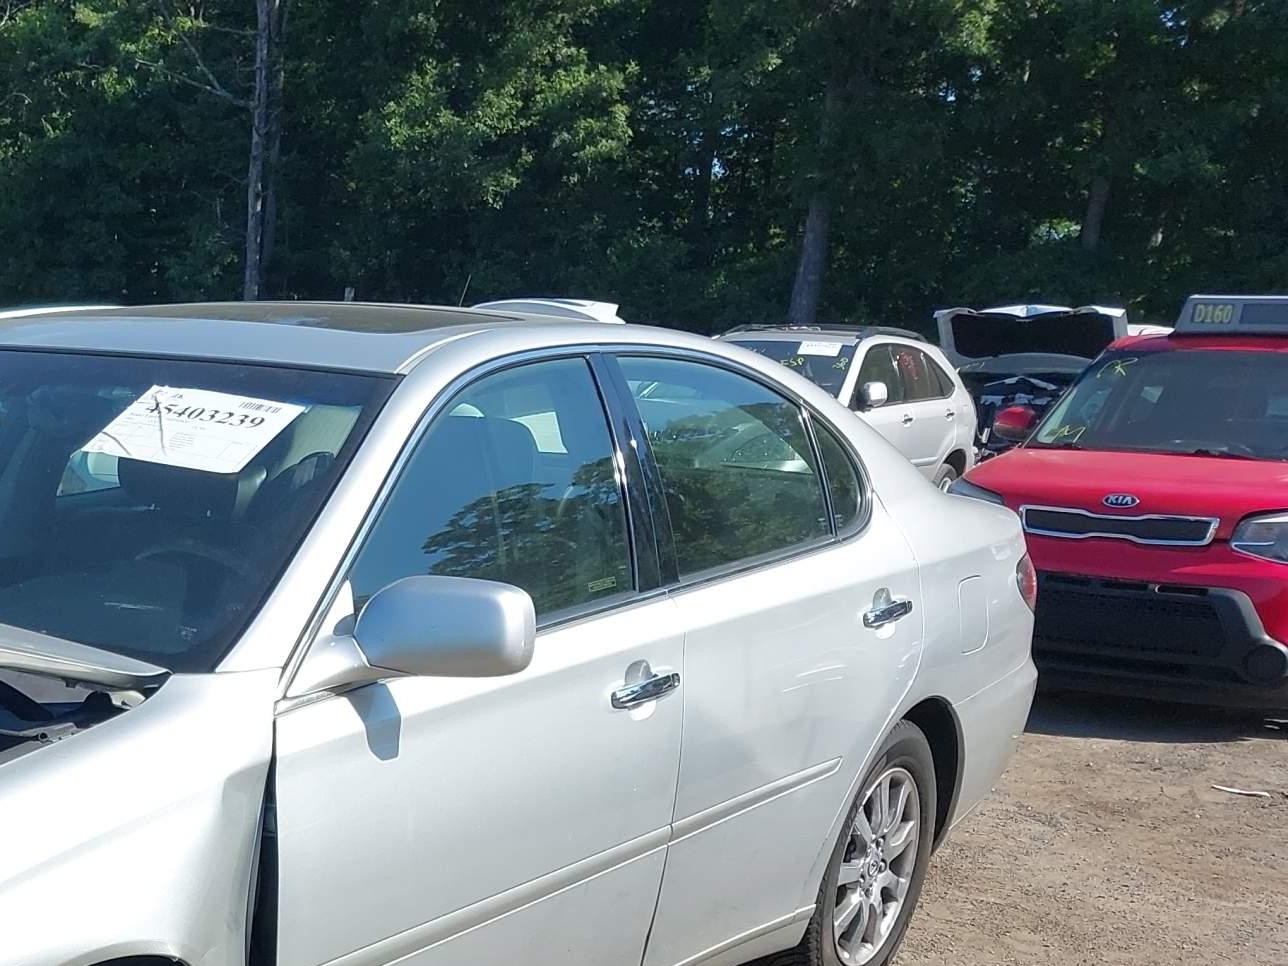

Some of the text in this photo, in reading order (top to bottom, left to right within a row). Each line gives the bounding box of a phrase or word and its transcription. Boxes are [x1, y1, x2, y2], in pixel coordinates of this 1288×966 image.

[1193, 304, 1233, 323] D160
[145, 402, 266, 429] 45403239
[1107, 495, 1132, 505] KIA
